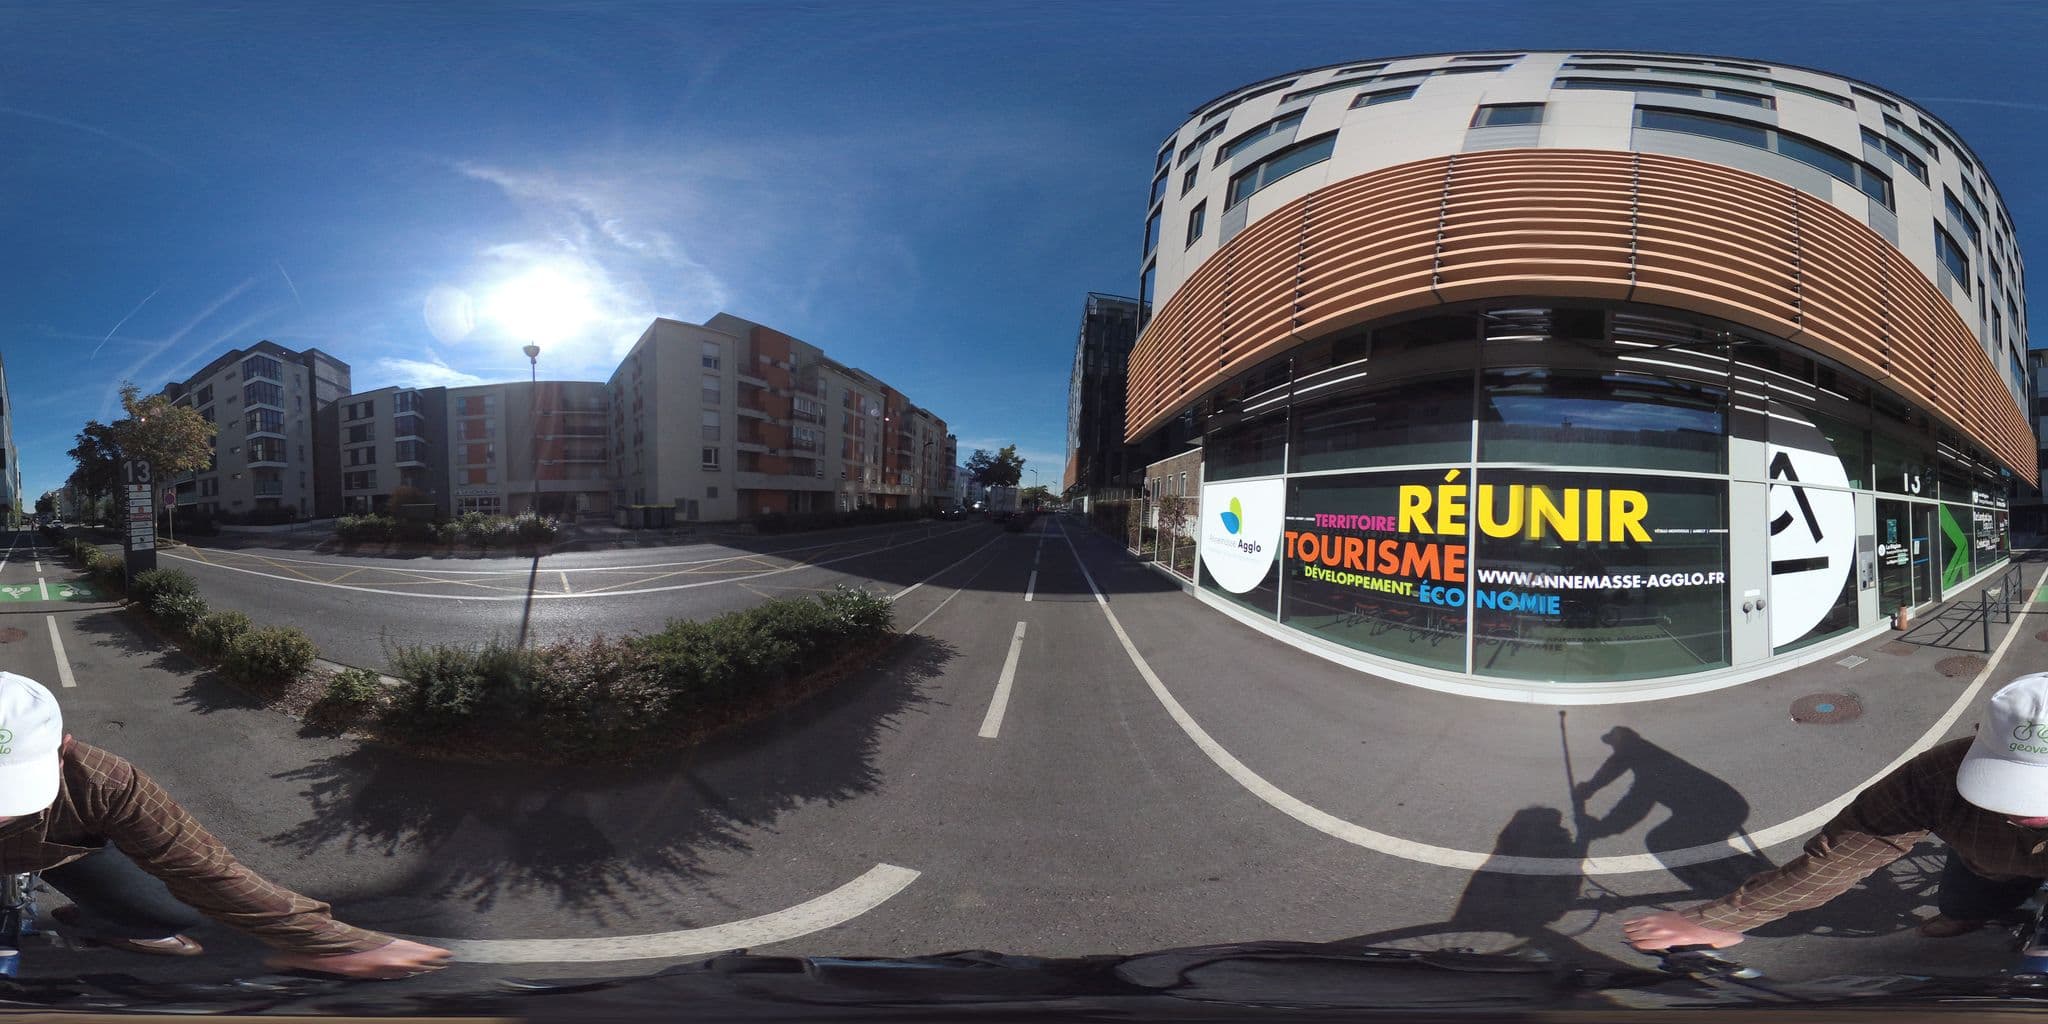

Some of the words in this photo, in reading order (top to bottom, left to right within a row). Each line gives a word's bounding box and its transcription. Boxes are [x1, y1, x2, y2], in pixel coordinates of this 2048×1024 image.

[123, 461, 150, 483] 13
[1398, 469, 1652, 543] RÉUNIR
[1315, 513, 1396, 532] TERRITOIRE
[1237, 538, 1262, 554] Agglo
[1285, 531, 1466, 582] TOURISME
[1304, 565, 1413, 597] DÉVELOPPEMENT
[1419, 580, 1561, 615] ÉCONOMIE
[1477, 569, 1726, 590] WWW.ANNEMASSE-AGGLO.FR
